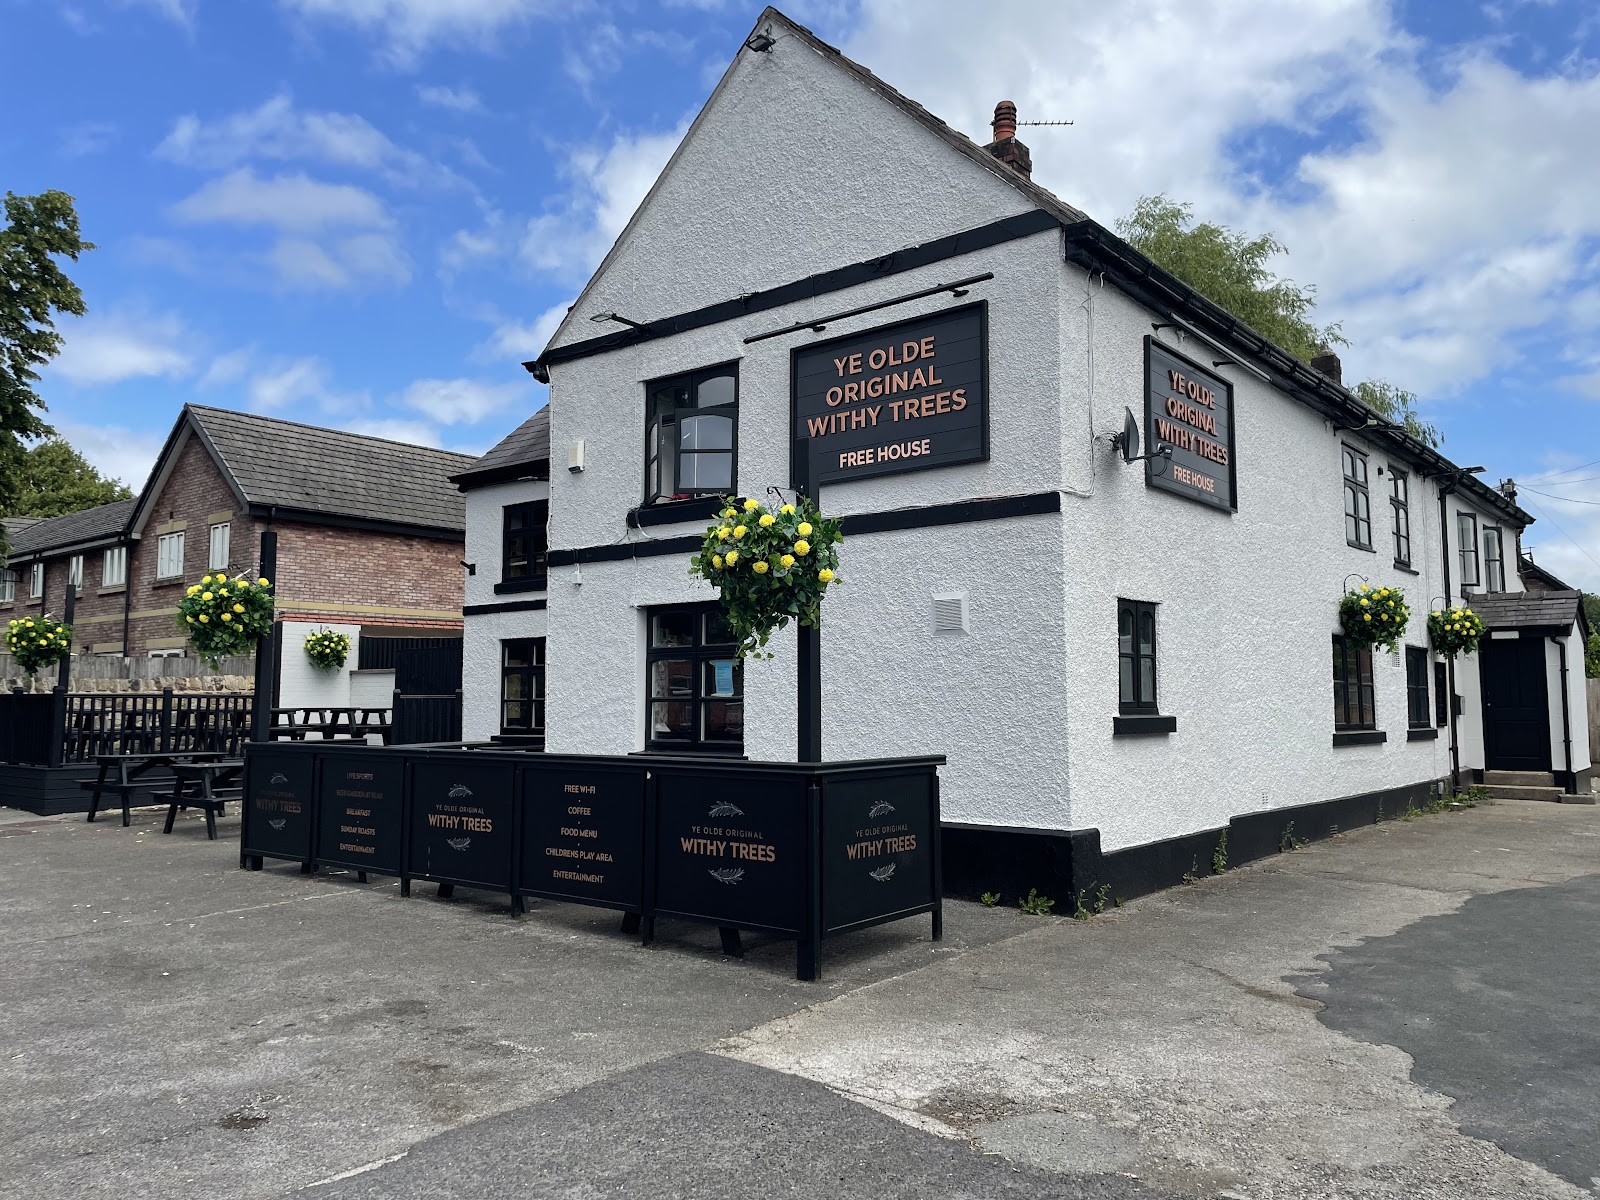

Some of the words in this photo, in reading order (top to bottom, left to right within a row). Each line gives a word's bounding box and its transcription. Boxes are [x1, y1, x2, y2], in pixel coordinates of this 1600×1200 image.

[834, 352, 863, 377] YE
[868, 336, 936, 370] OLDE
[825, 365, 943, 407] ORIGINAL
[1170, 369, 1186, 394] YE
[1187, 380, 1216, 410] OLDE
[807, 405, 883, 438] WITHY
[888, 388, 967, 422] TREES
[1166, 396, 1219, 437] ORIGINAL
[1156, 418, 1196, 452] WITHY
[1196, 436, 1229, 466] TREES
[839, 448, 874, 468] FREE
[877, 439, 931, 463] HOUSE
[1173, 465, 1190, 485] FREE
[1191, 472, 1215, 493] HOUSE
[356, 772, 374, 780] SPORTS
[564, 784, 579, 793] FREE
[580, 785, 596, 794] WI-FI
[256, 798, 278, 810] WITHY
[280, 800, 302, 814] TREES
[346, 808, 372, 816] BREAKFAST
[459, 806, 485, 814] ORIGINAL
[567, 806, 592, 816] COFFEE
[341, 825, 357, 833] SUNDAY
[358, 827, 376, 836] ROASTS
[428, 814, 460, 830] WITHY
[462, 817, 493, 832] TREES
[865, 827, 880, 836] OLDE
[882, 824, 908, 834] ORIGINAL
[561, 827, 579, 836] FOOD
[580, 829, 598, 838] MENU
[692, 826, 701, 834] YE
[703, 827, 723, 836] OLDE
[726, 829, 763, 839] ORIGINAL
[340, 843, 376, 854] ENTERTAINMENT
[681, 837, 727, 857] WITHY
[730, 842, 776, 862] TREES
[847, 840, 883, 860] WITHY
[885, 834, 917, 854] TREES
[546, 848, 579, 858] CHILDRENS
[580, 851, 595, 860] PLAY
[596, 853, 613, 862] AREA
[553, 870, 604, 883] ENTERTAINMENT
